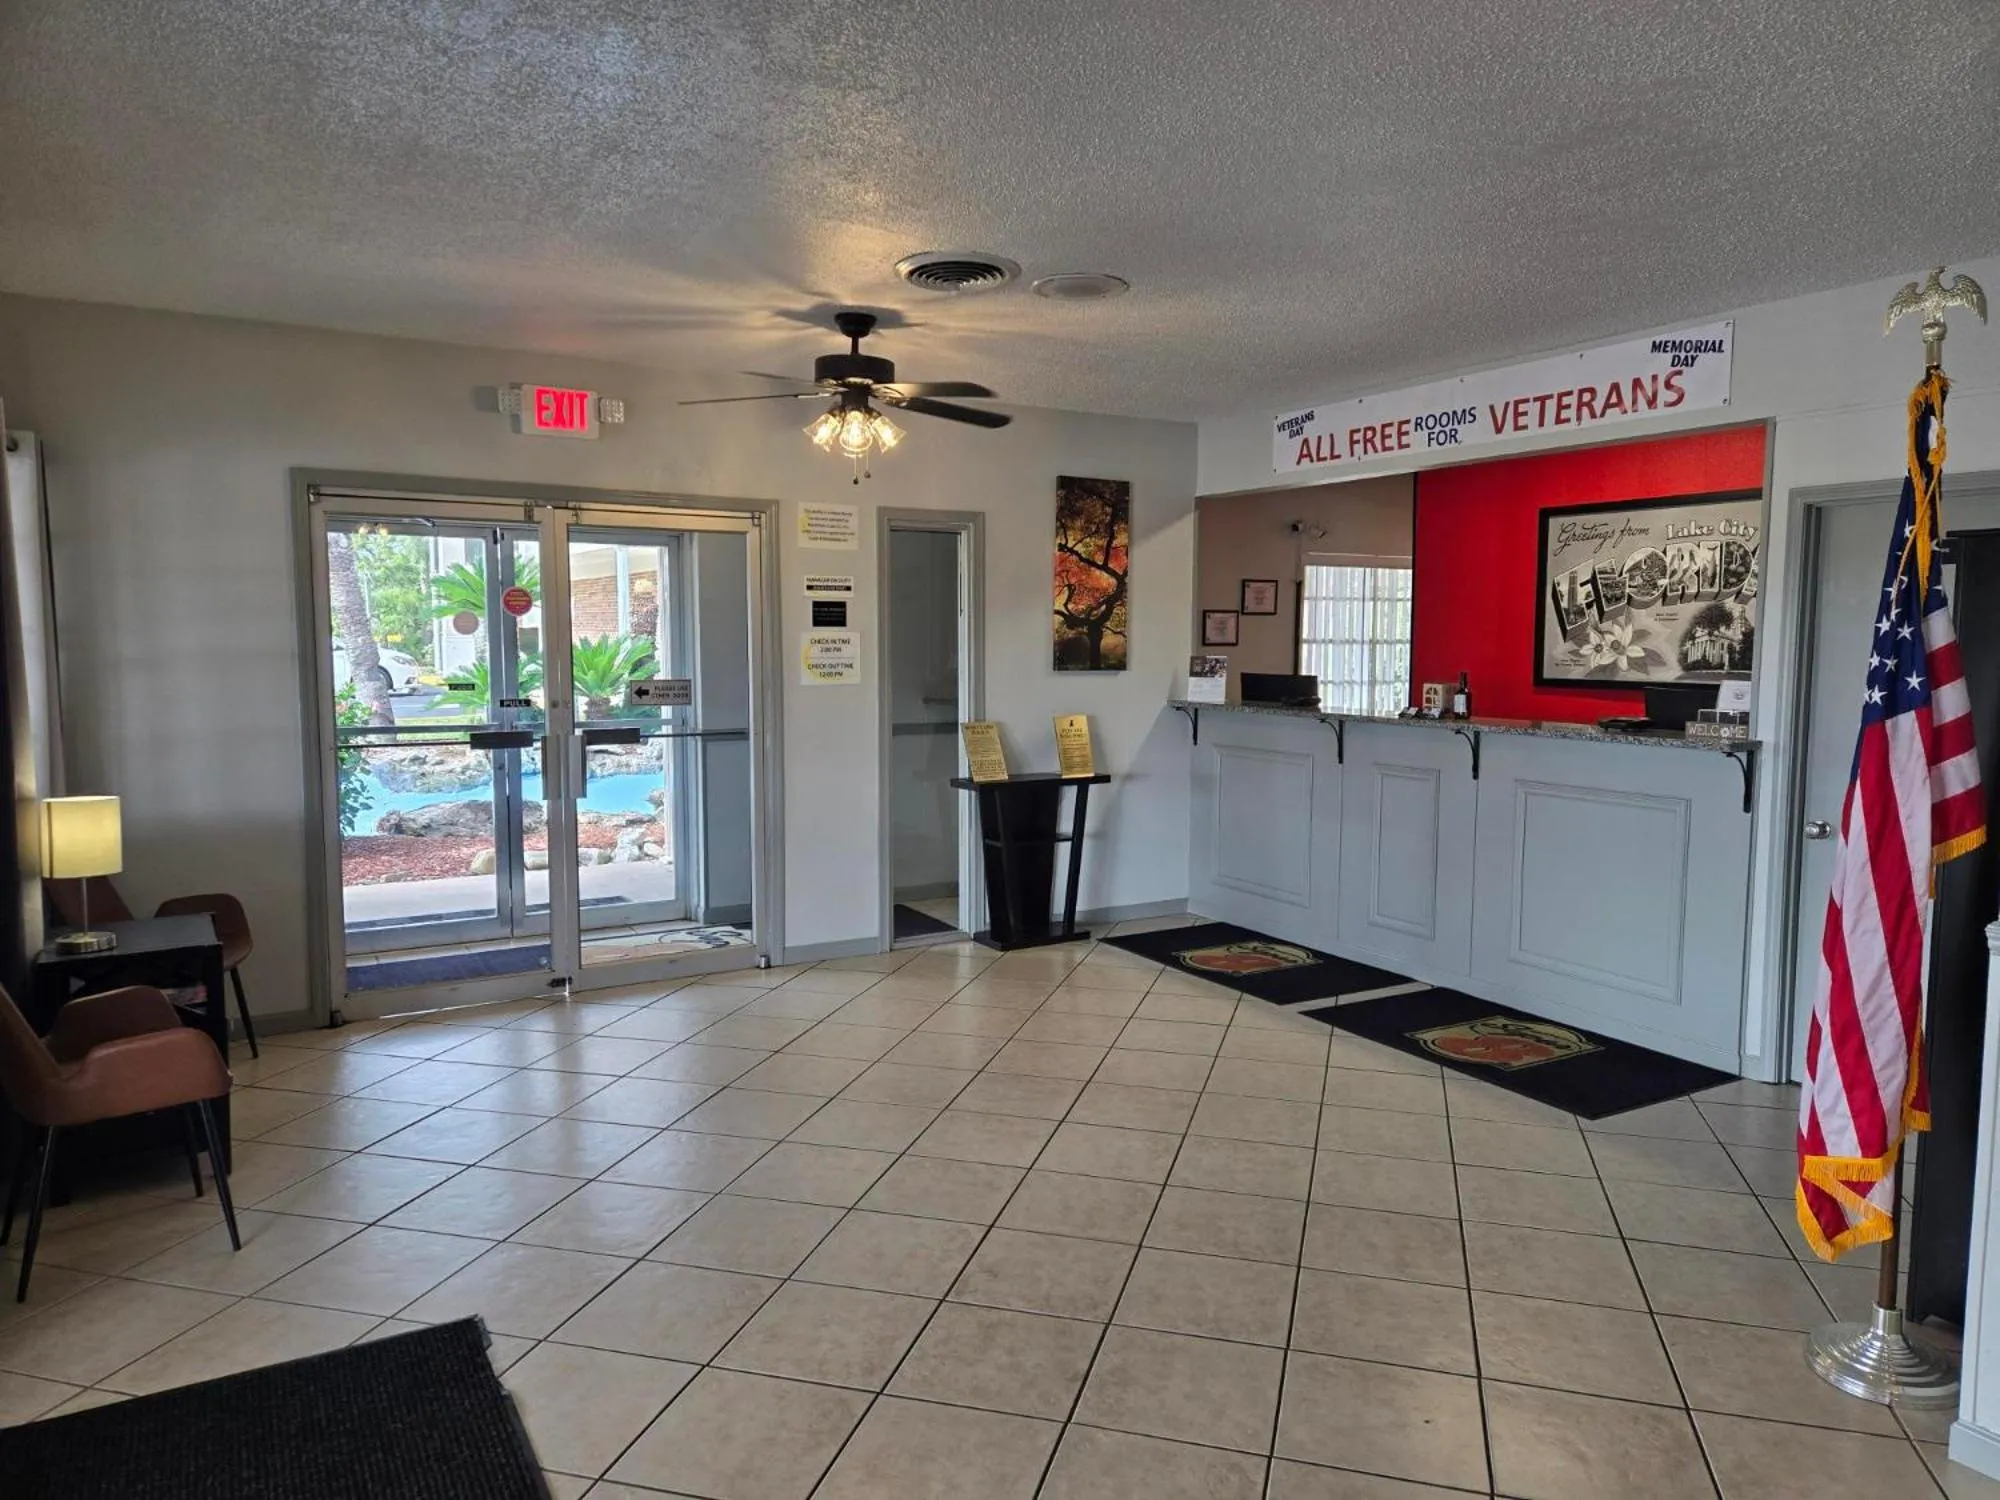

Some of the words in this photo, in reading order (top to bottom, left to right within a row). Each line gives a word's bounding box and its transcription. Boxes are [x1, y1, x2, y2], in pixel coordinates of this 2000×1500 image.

[1651, 339, 1724, 353] MEMORIAL
[1670, 354, 1699, 368] DAY
[535, 387, 589, 432] EXIT
[1488, 369, 1686, 435] VETERANS
[1276, 410, 1315, 433] VETERANS
[1288, 425, 1304, 439] DAY
[1414, 406, 1477, 433] ROOMS
[1296, 433, 1342, 466] ALL
[1349, 419, 1412, 457] FREE
[1553, 522, 1616, 557] Greetings
[1612, 518, 1650, 548] from
[1665, 519, 1714, 541] Lake
[1719, 518, 1760, 541] City
